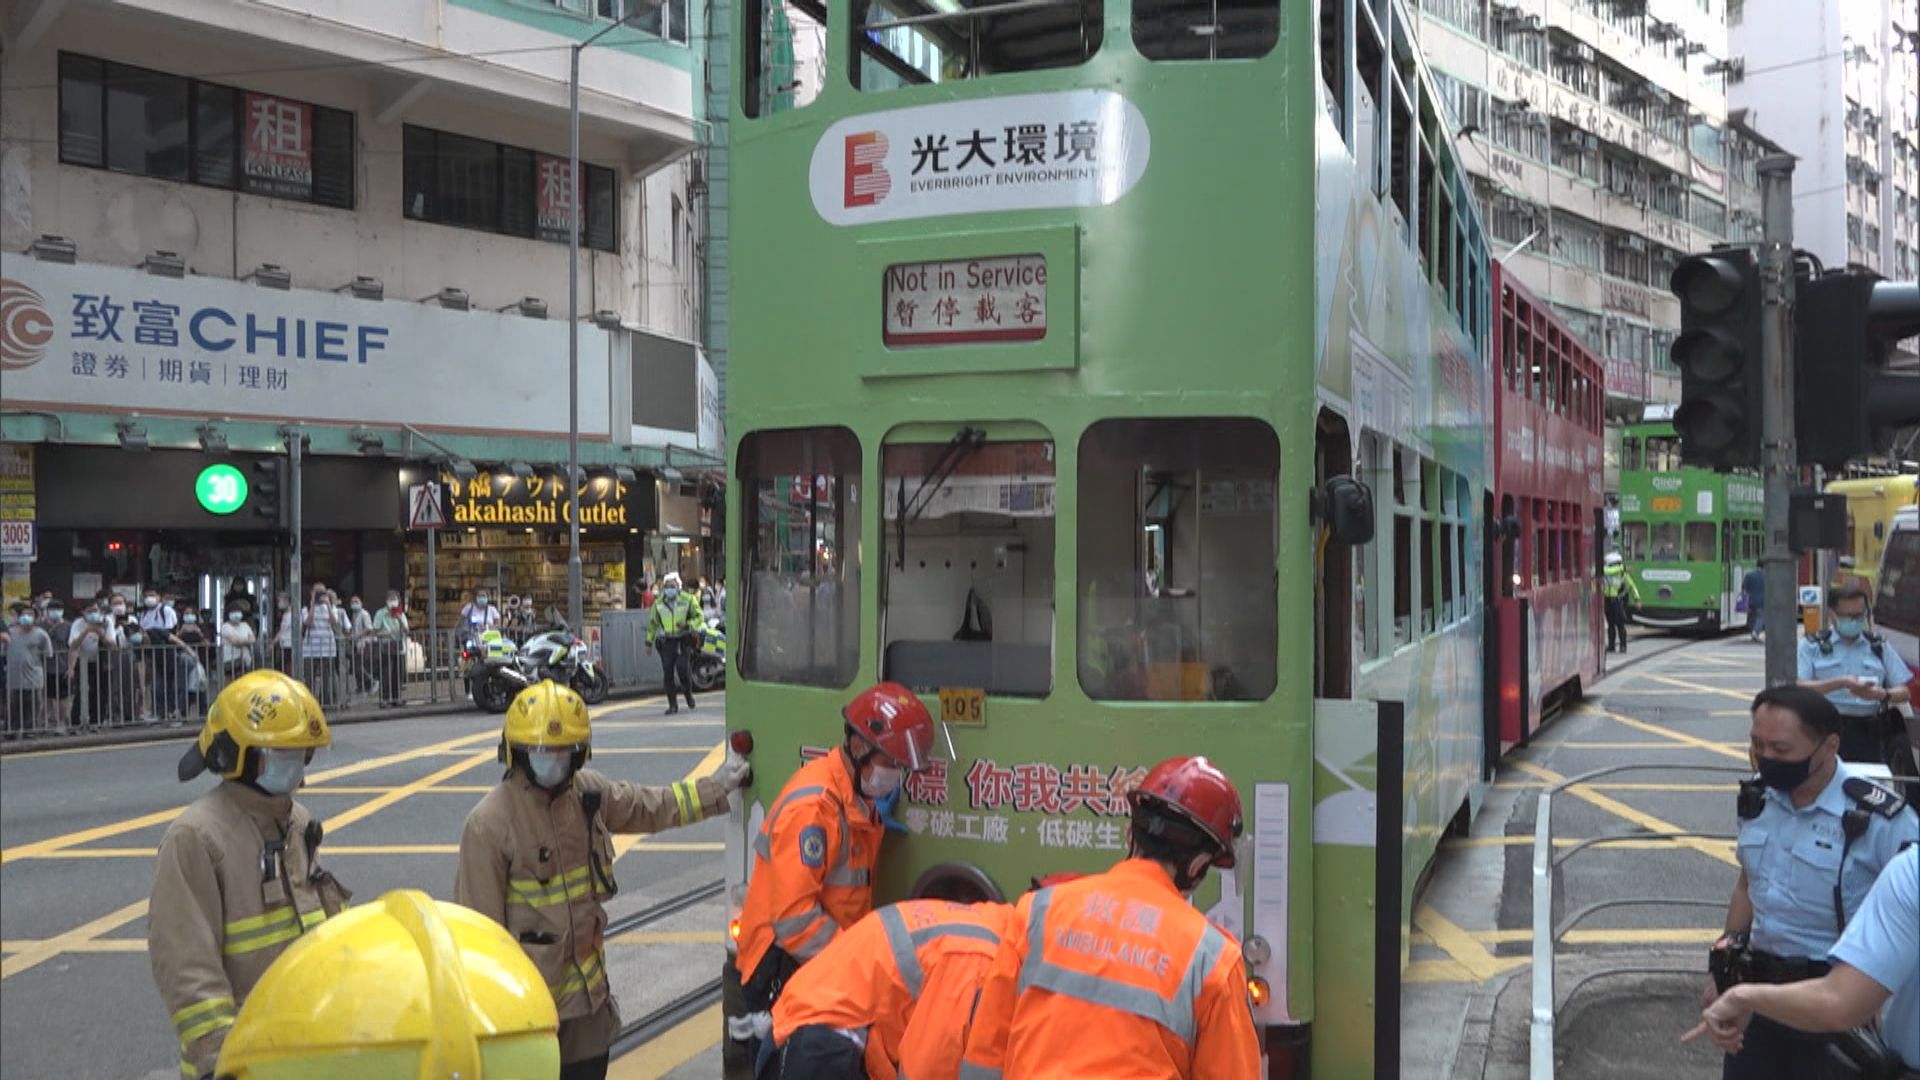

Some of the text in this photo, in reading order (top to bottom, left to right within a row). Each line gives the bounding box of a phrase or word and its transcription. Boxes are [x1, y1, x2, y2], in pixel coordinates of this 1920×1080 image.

[251, 98, 307, 157] 租
[911, 121, 1097, 175] 光大環境
[910, 167, 1097, 193] EVERBRIGHT ENVIRONMENT
[890, 257, 1047, 292] Not in Service
[894, 290, 1043, 328] 暫停載客
[70, 293, 390, 364] 致富 CHIEF
[71, 351, 289, 391] 證券 期貨 理財
[207, 474, 238, 503] 30
[3, 525, 30, 545] 3005
[942, 695, 980, 720] 105
